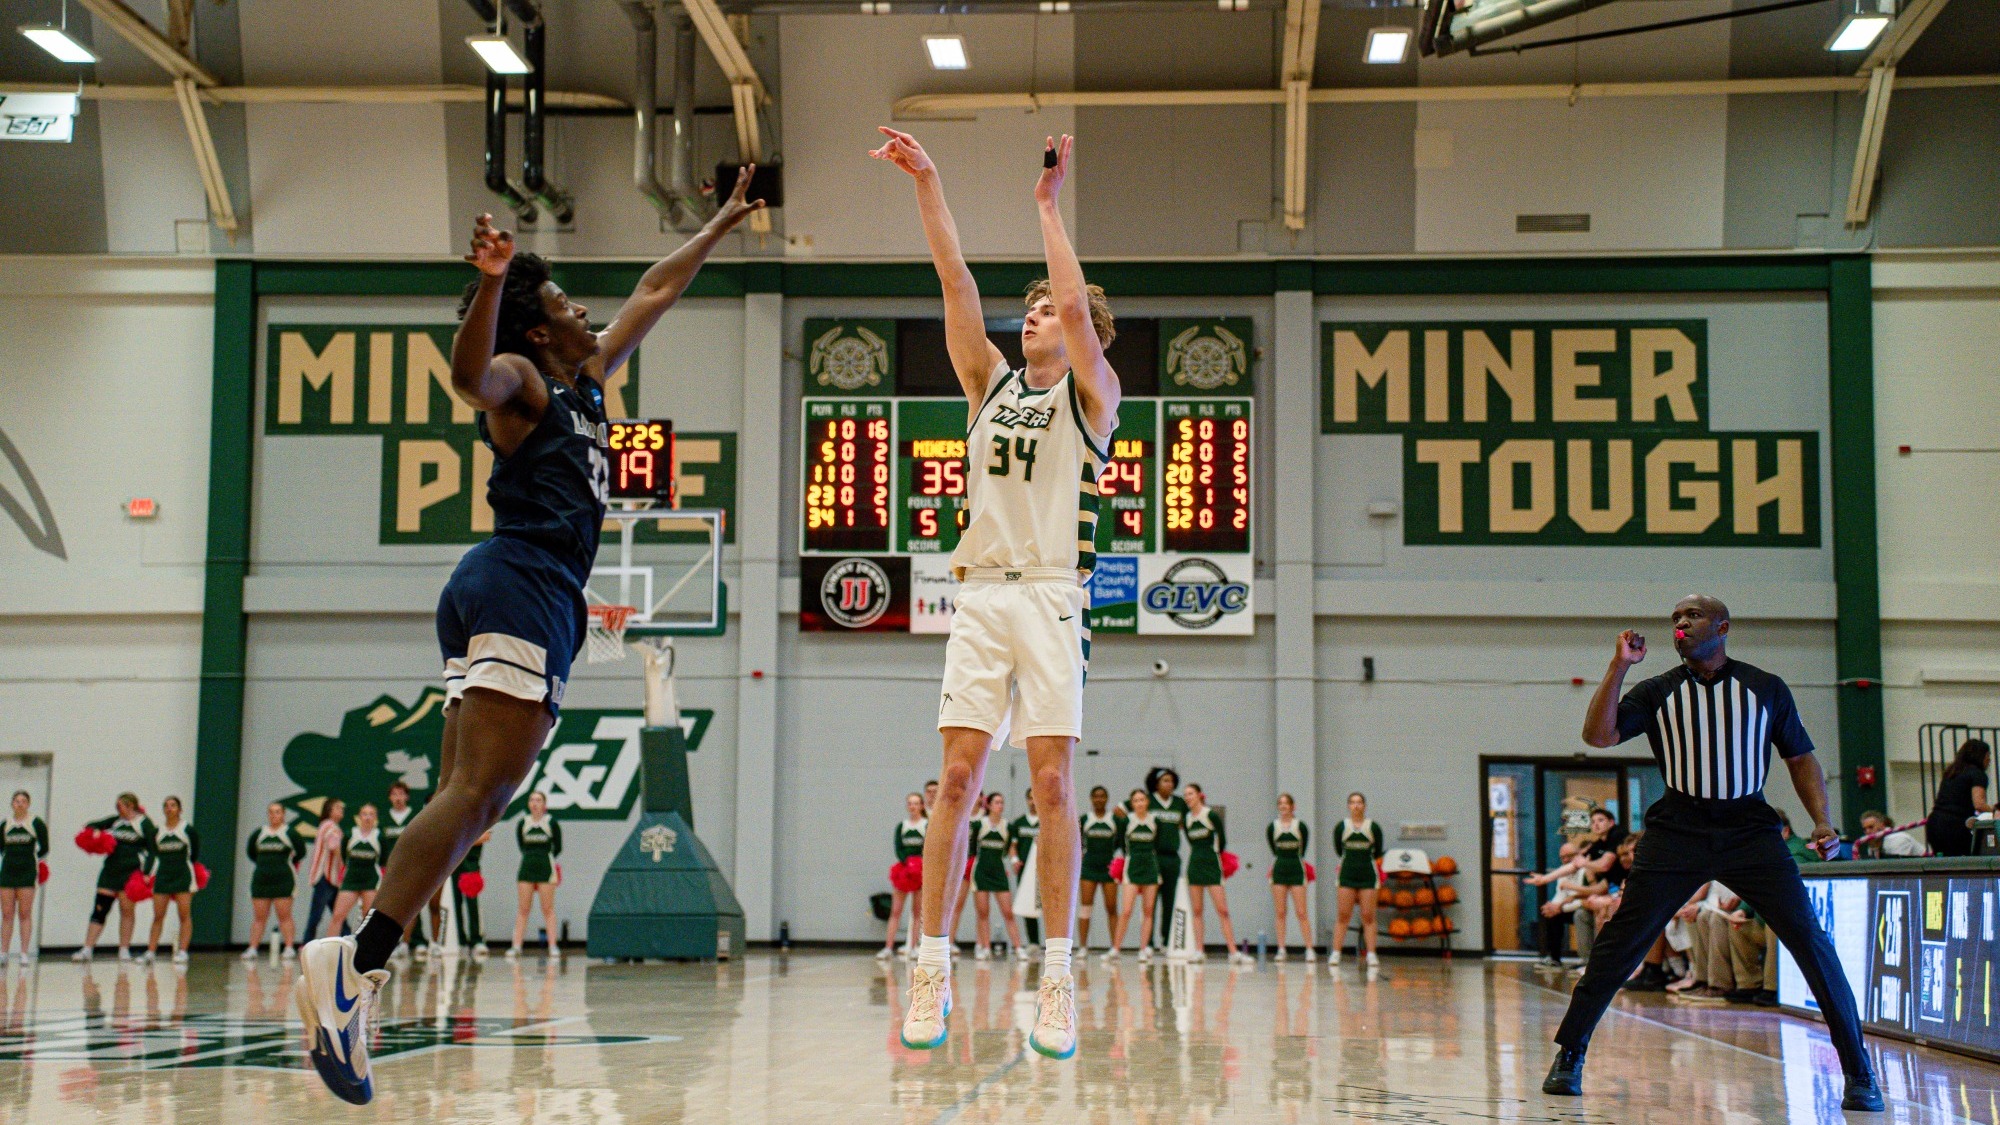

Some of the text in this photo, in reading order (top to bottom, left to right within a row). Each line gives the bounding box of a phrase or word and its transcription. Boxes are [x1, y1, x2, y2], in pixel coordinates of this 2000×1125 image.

[1333, 328, 1699, 423] MINER
[609, 424, 664, 450] 2:25
[829, 420, 888, 440] 1 0 16
[1179, 420, 1246, 440] 5 0 0
[822, 442, 888, 462] 5 0 2
[913, 440, 966, 458] MINERS
[989, 434, 1038, 481] 34
[1172, 442, 1246, 462] 12 0 2
[621, 450, 653, 489] 19
[815, 464, 888, 484] 11 0 0
[923, 461, 963, 494] 35
[1098, 461, 1141, 494] 24
[1166, 463, 1246, 484] 20 2 5
[807, 485, 888, 506] 23 0 2
[1166, 486, 1246, 506] 25 1 4
[1416, 439, 1804, 534] TOUGH
[907, 497, 941, 509] FOULS
[1111, 497, 1145, 509] FOULS
[809, 507, 887, 528] 34 1 7
[920, 509, 937, 536] 5
[1124, 511, 1141, 534] 4
[1167, 508, 1246, 528] 32 0 2
[907, 540, 940, 553] SCORE
[1110, 541, 1144, 552] SCORE
[1094, 573, 1135, 586] County
[840, 577, 871, 611] JJ
[1094, 587, 1125, 599] Bank
[1145, 583, 1247, 612] GLVC
[508, 716, 698, 810] &T
[1955, 957, 1962, 1022] 5
